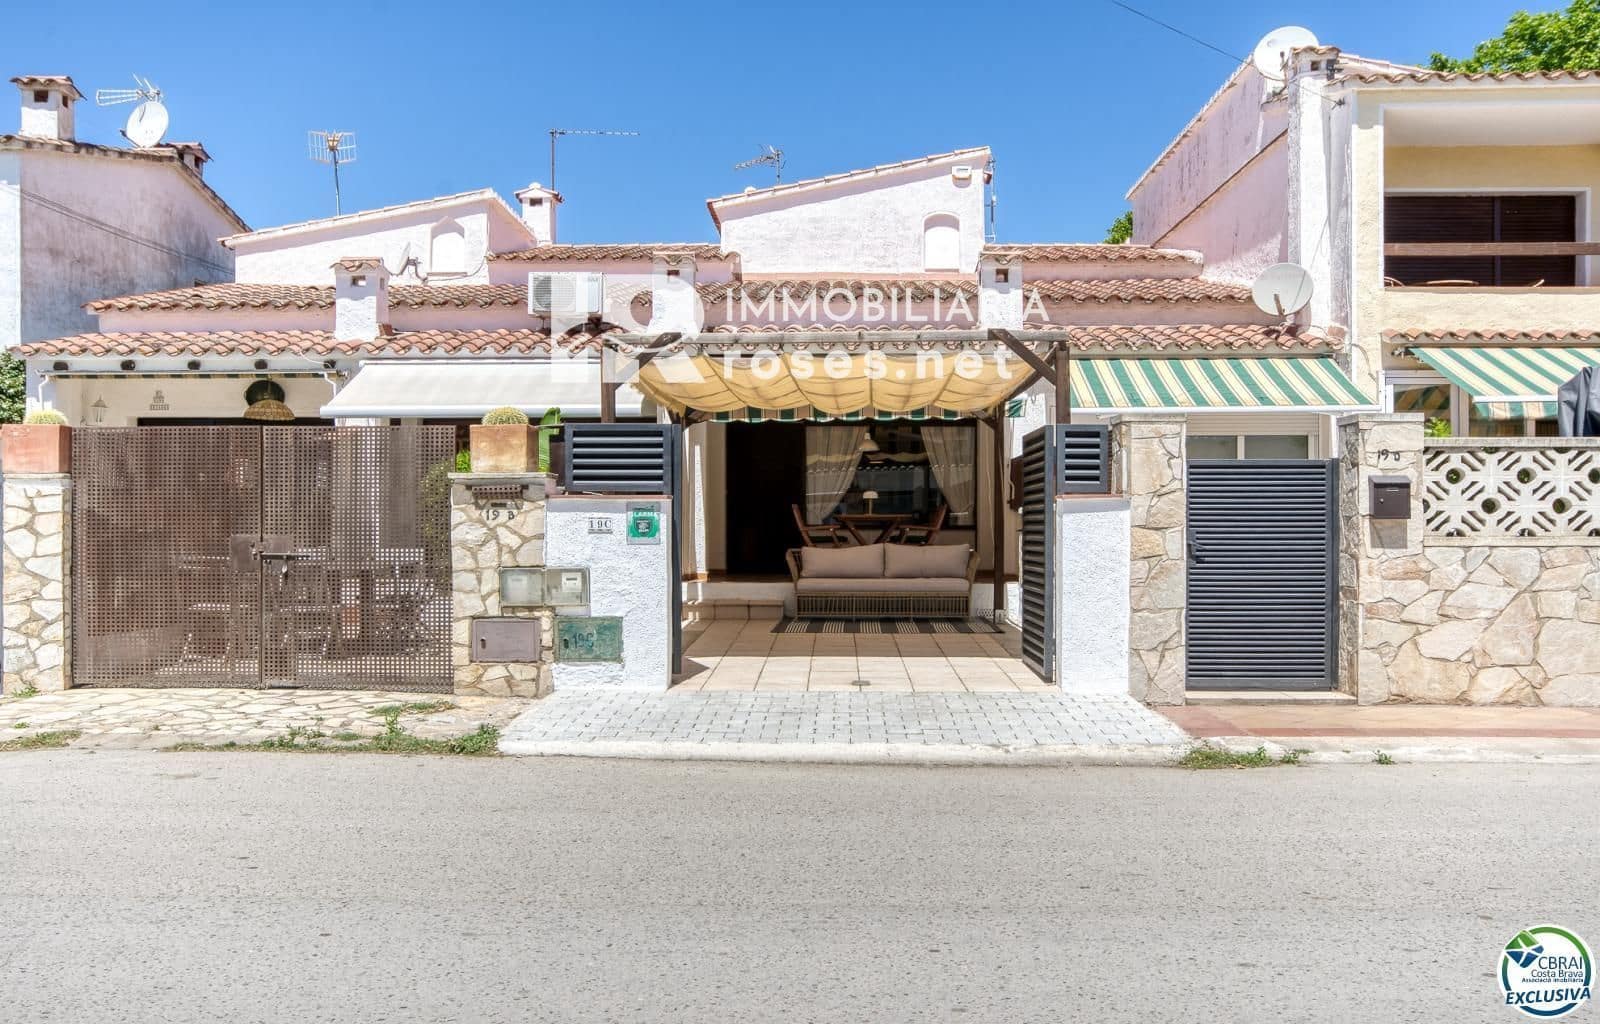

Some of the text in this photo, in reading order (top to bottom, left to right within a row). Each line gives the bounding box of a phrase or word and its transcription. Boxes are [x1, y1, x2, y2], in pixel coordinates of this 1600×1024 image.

[486, 509, 515, 521] 19 B
[590, 519, 612, 529] 19C
